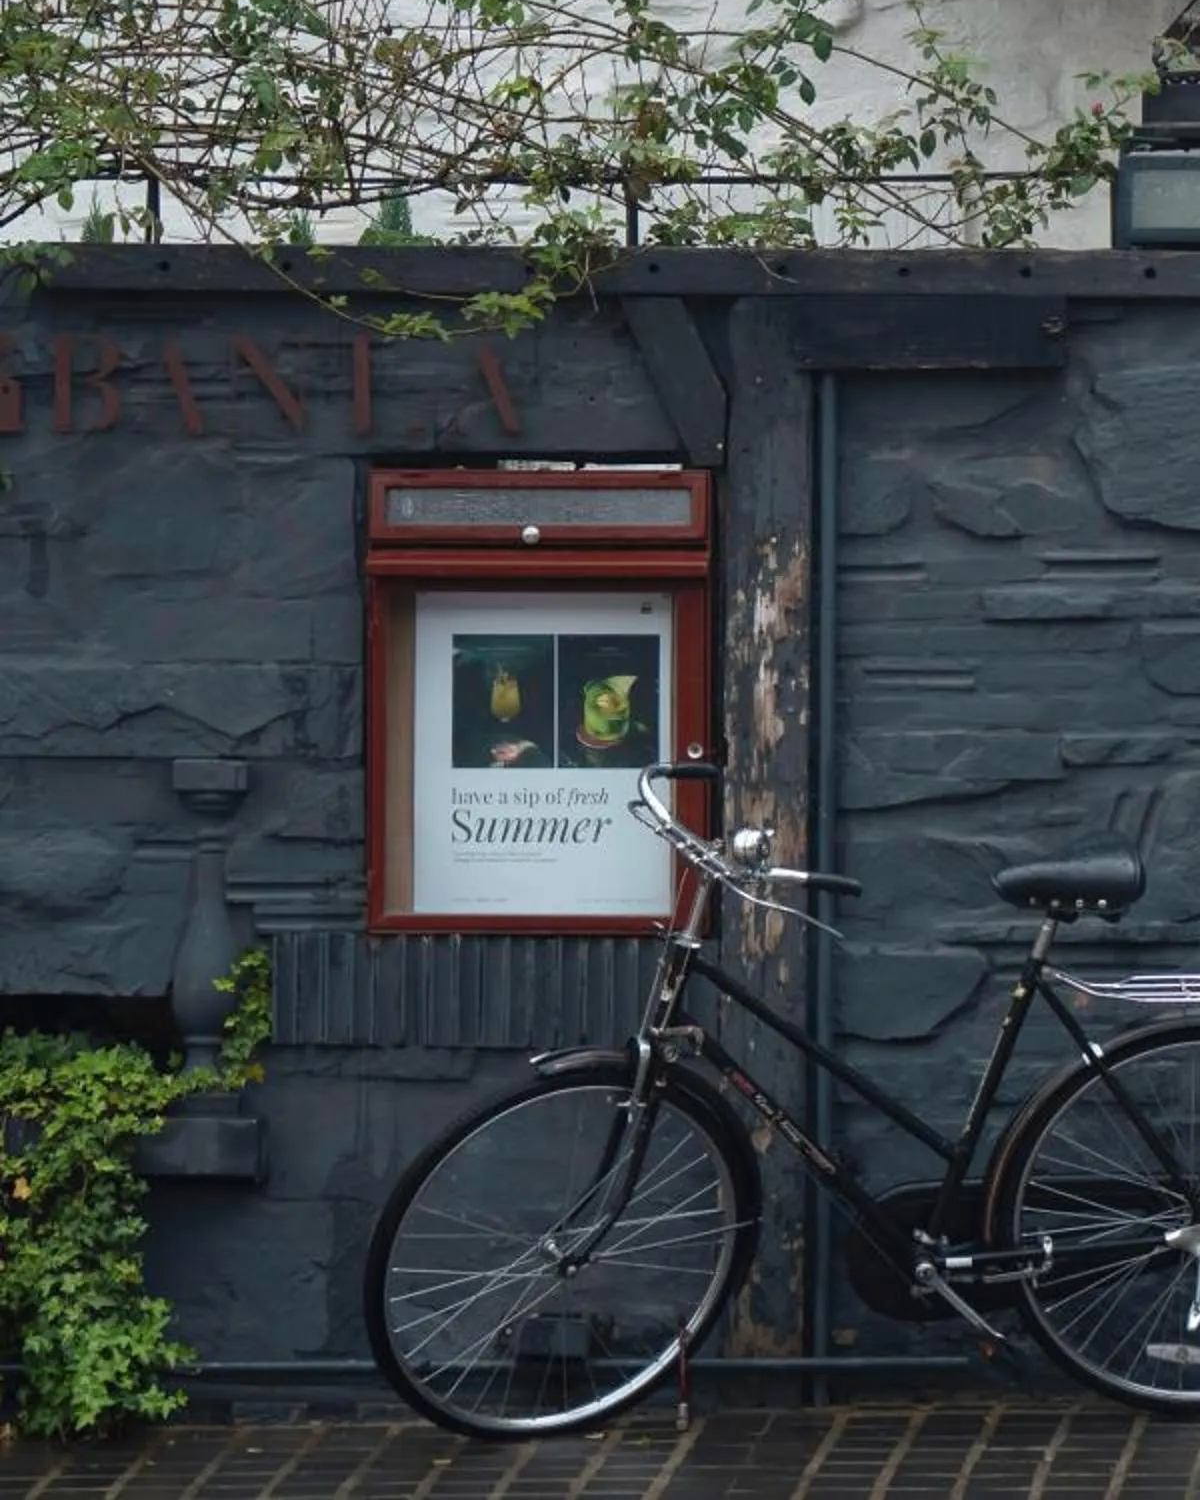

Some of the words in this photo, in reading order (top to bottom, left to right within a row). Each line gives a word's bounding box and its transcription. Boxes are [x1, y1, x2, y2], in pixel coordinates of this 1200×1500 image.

[451, 787, 494, 805] have
[498, 791, 508, 805] a
[513, 787, 540, 809] sip
[545, 787, 565, 805] of
[566, 787, 610, 809] fresh
[451, 808, 613, 844] Summer
